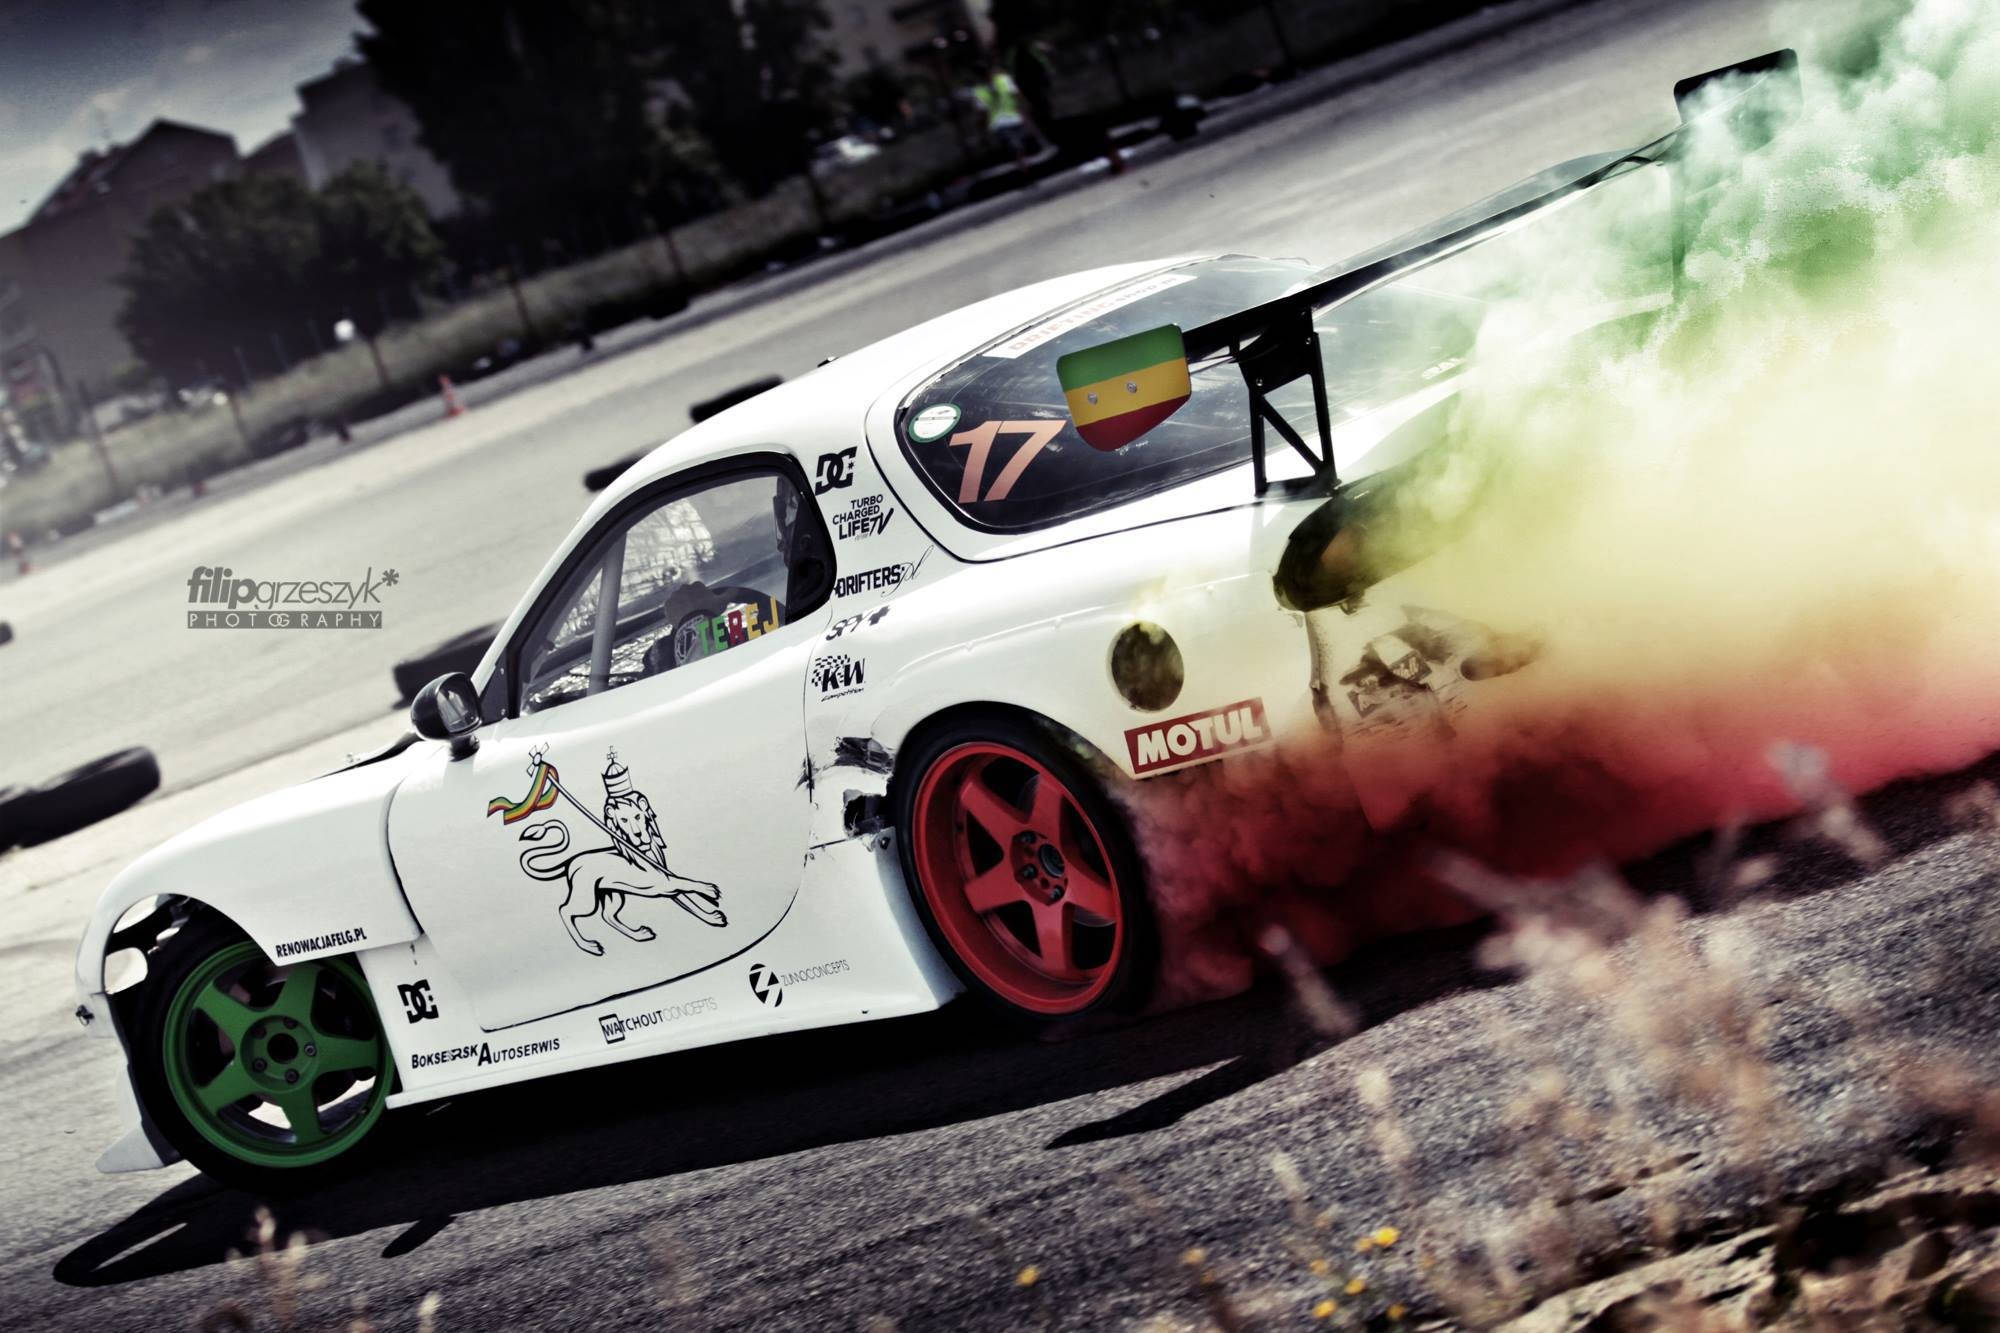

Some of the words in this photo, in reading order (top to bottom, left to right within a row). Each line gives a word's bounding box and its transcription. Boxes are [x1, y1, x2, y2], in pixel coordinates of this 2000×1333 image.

[815, 446, 858, 496] DC
[949, 420, 1067, 504] 17
[832, 505, 880, 525] CHARGED
[851, 494, 883, 511] TURBO
[696, 595, 780, 657] TEREJ
[1137, 707, 1263, 767] MOTUL
[275, 927, 368, 958] RENOWACJAFELG.PL
[397, 979, 439, 1024] DC
